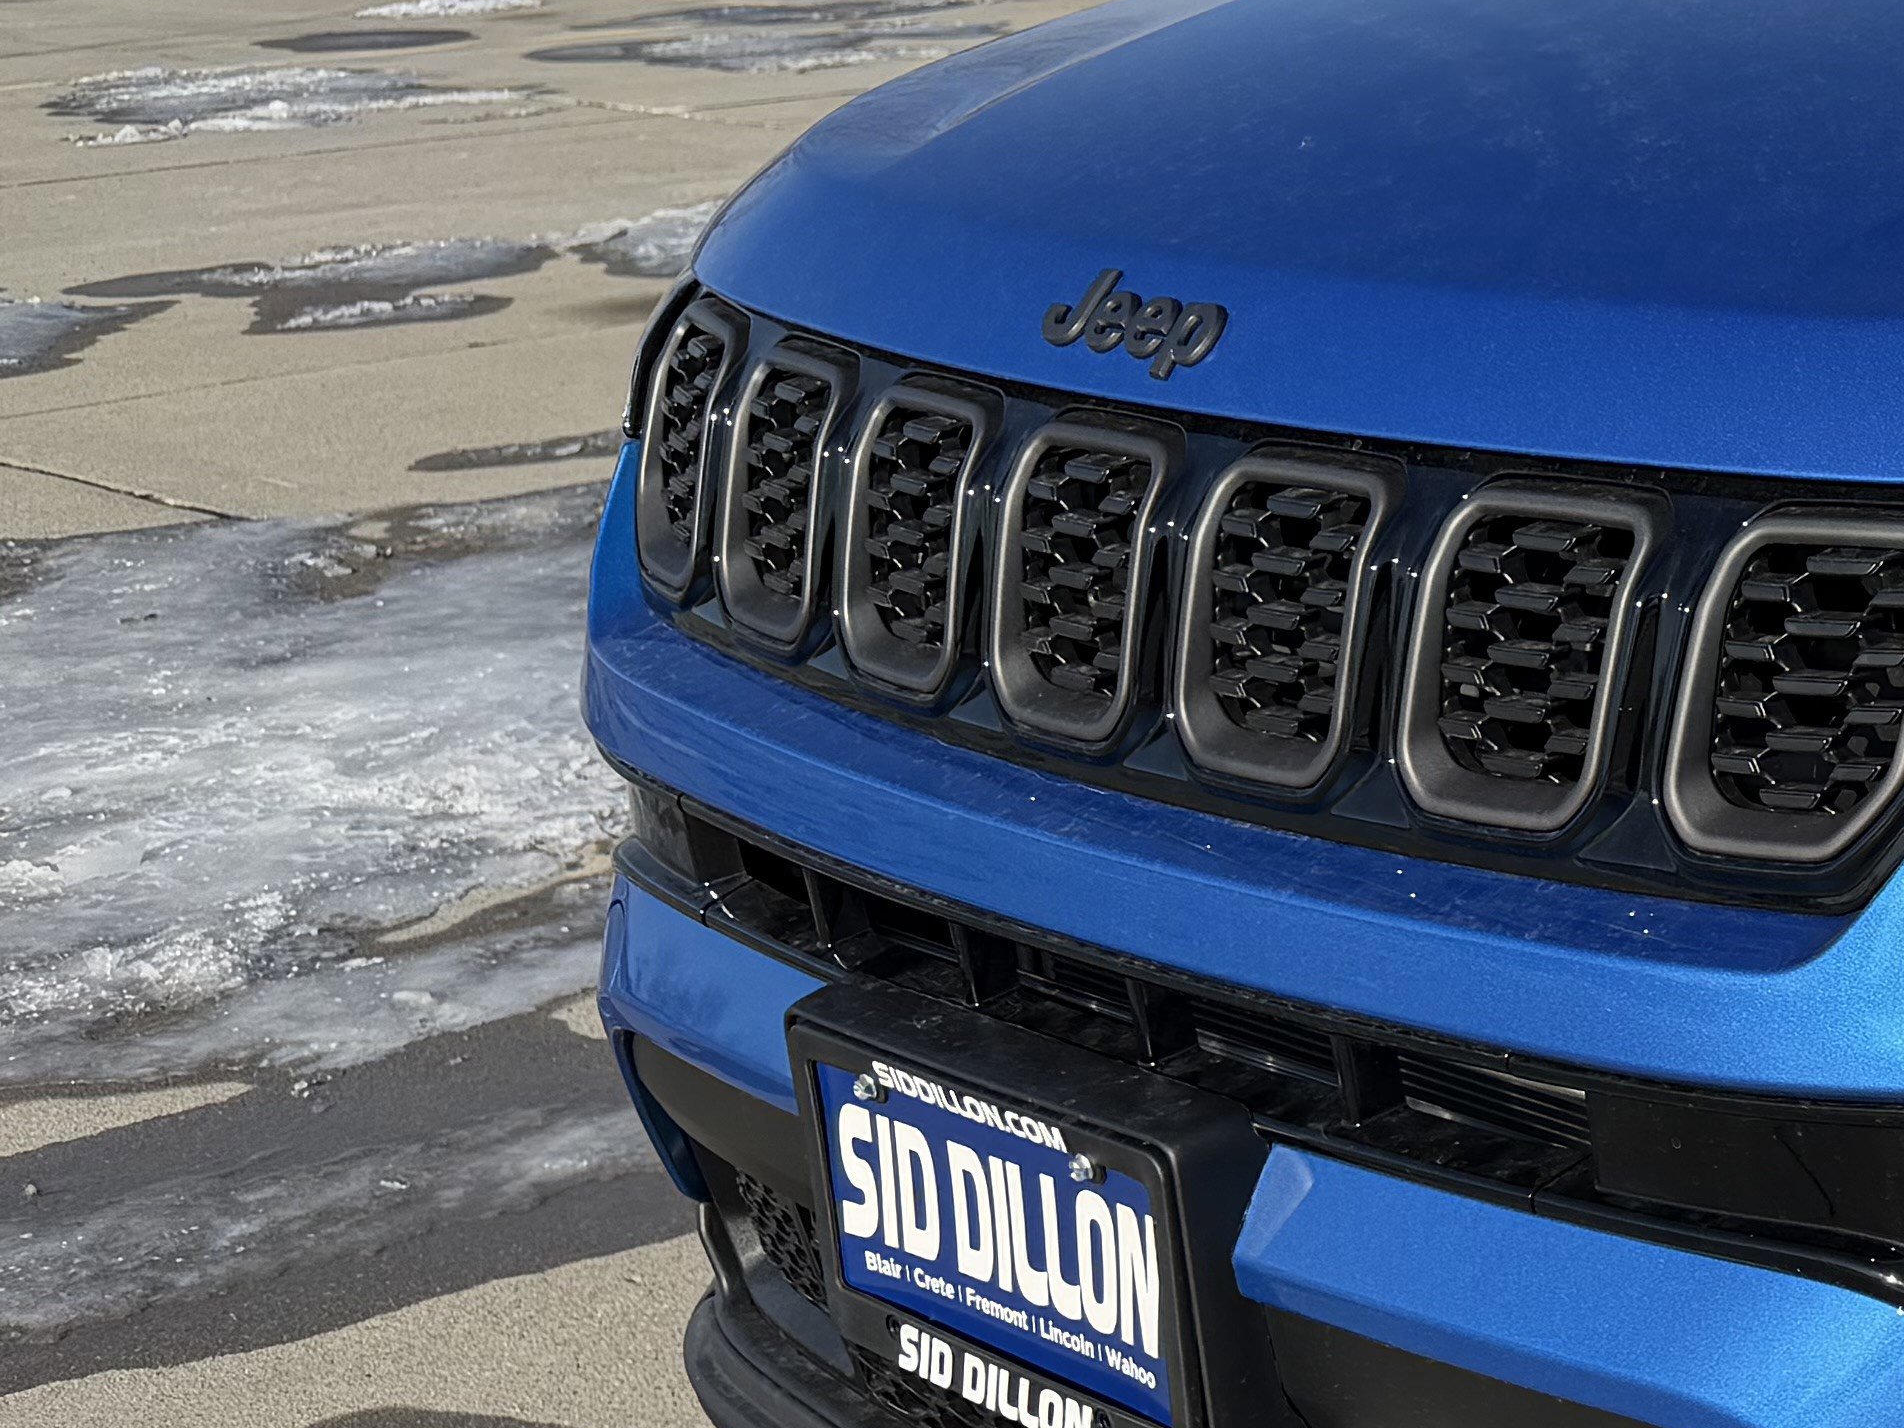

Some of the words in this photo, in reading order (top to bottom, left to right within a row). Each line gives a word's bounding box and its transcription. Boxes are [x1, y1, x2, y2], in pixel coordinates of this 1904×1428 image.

[1041, 268, 1229, 381] Jeep
[871, 1060, 1068, 1153] SIDDILLON.COM
[838, 1102, 941, 1261] SID
[946, 1139, 1160, 1359] DILLON
[864, 1250, 902, 1280] Blair
[913, 1267, 955, 1300] Crete
[966, 1288, 1030, 1330] Fremont
[1039, 1317, 1096, 1359] Lincoln
[1105, 1346, 1157, 1390] Wahoo
[898, 1323, 954, 1390] SID
